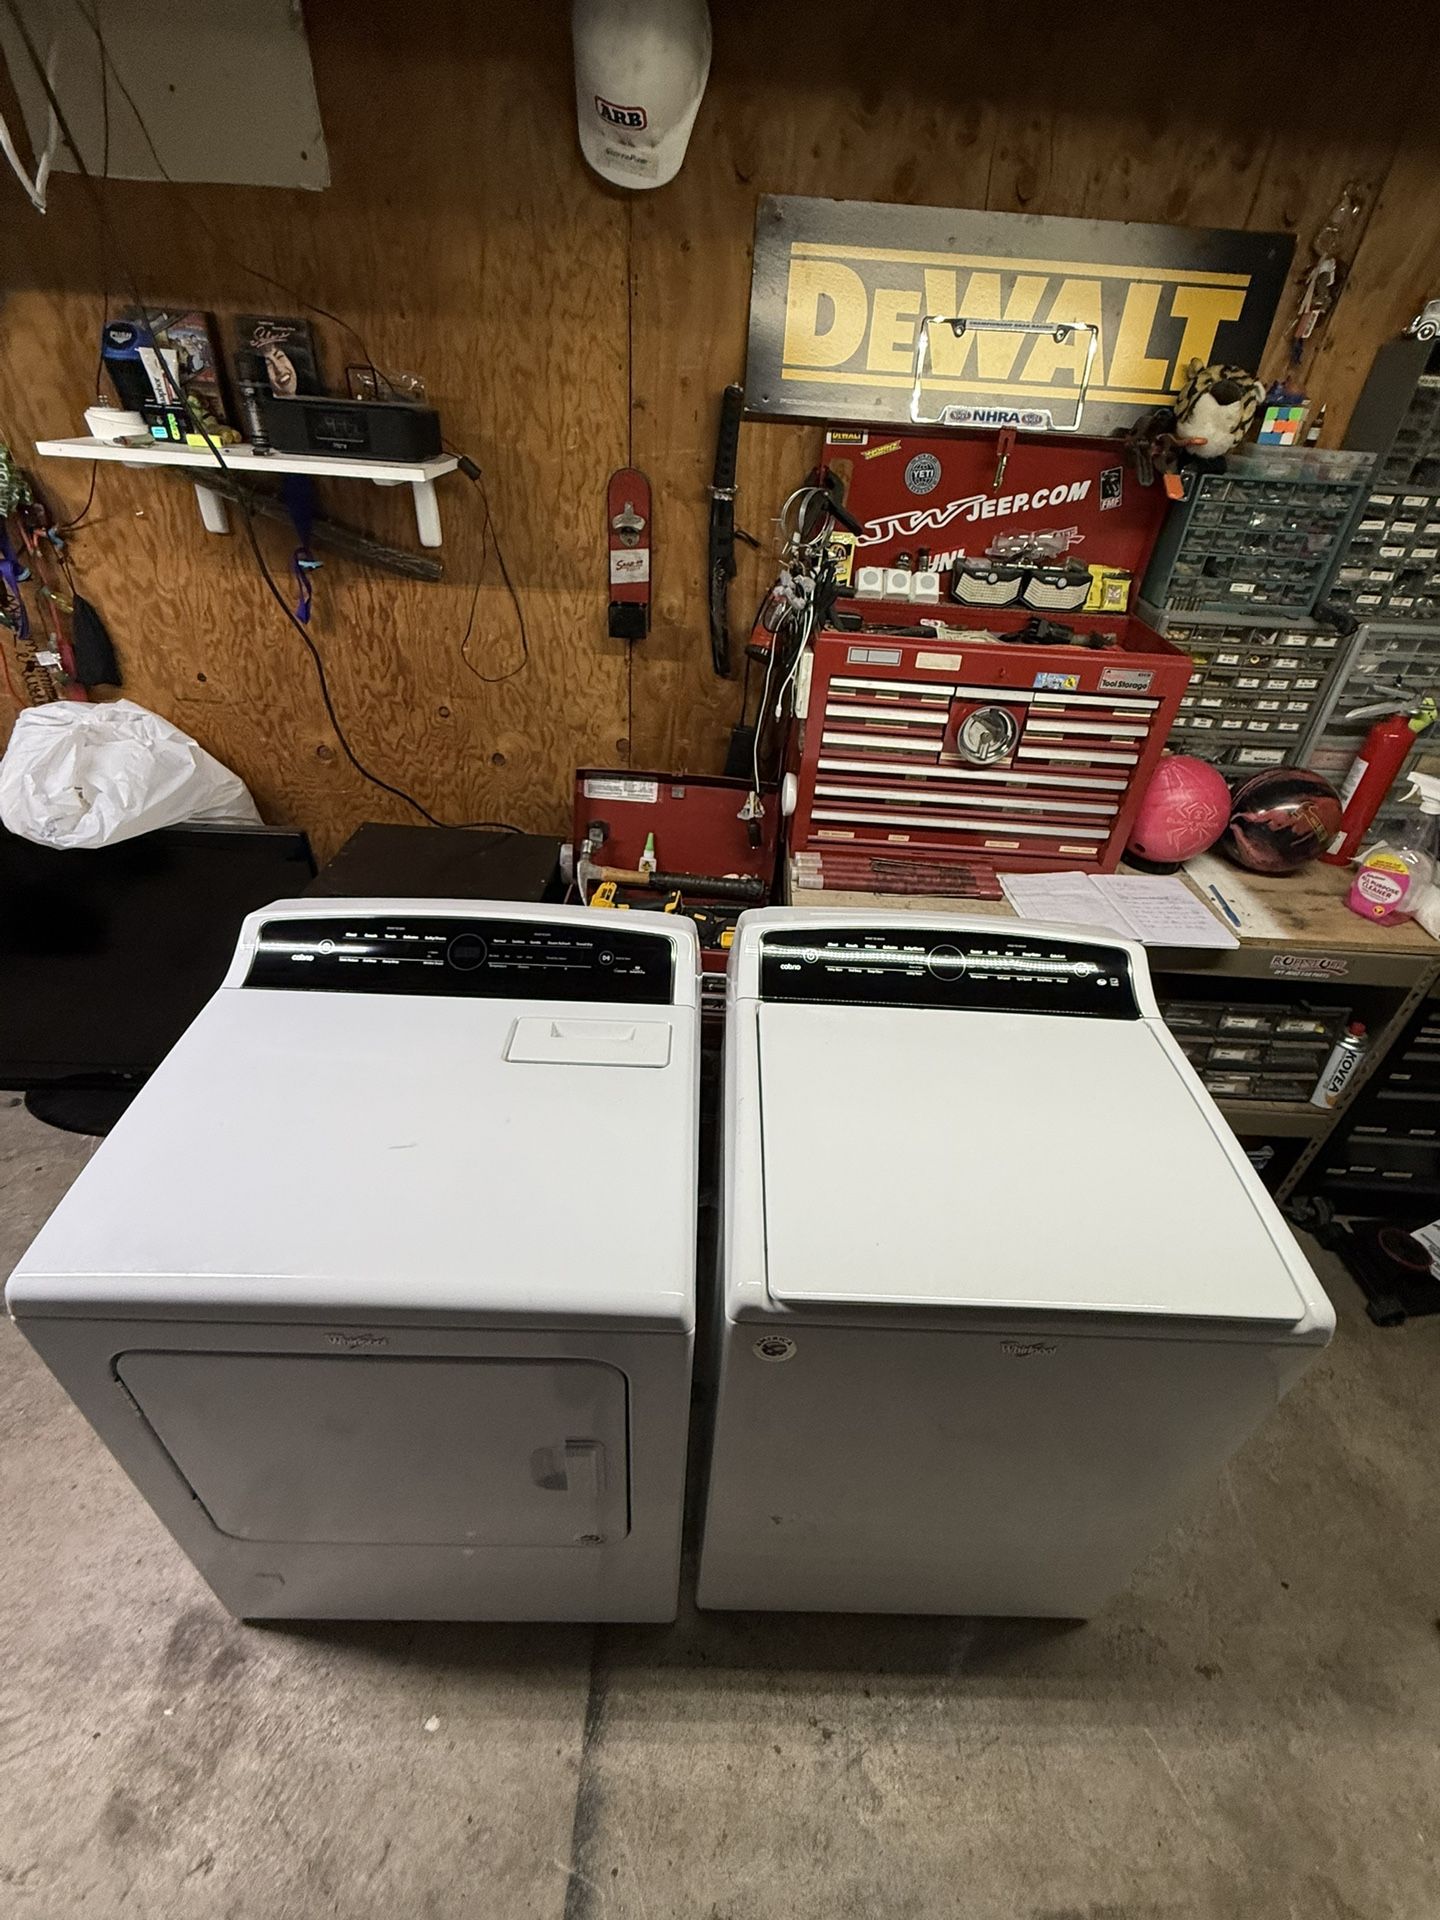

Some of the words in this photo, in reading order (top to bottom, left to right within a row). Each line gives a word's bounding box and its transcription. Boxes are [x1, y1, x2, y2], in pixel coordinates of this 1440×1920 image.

[600, 103, 643, 127] ARB
[972, 409, 1021, 424] NHRA
[913, 469, 934, 478] YETI
[1101, 678, 1118, 688] Tool
[1117, 681, 1149, 691] Storage
[1361, 882, 1393, 899] CLEANER
[1370, 880, 1400, 896] PURPOSE
[1328, 1050, 1359, 1094] KOVEA
